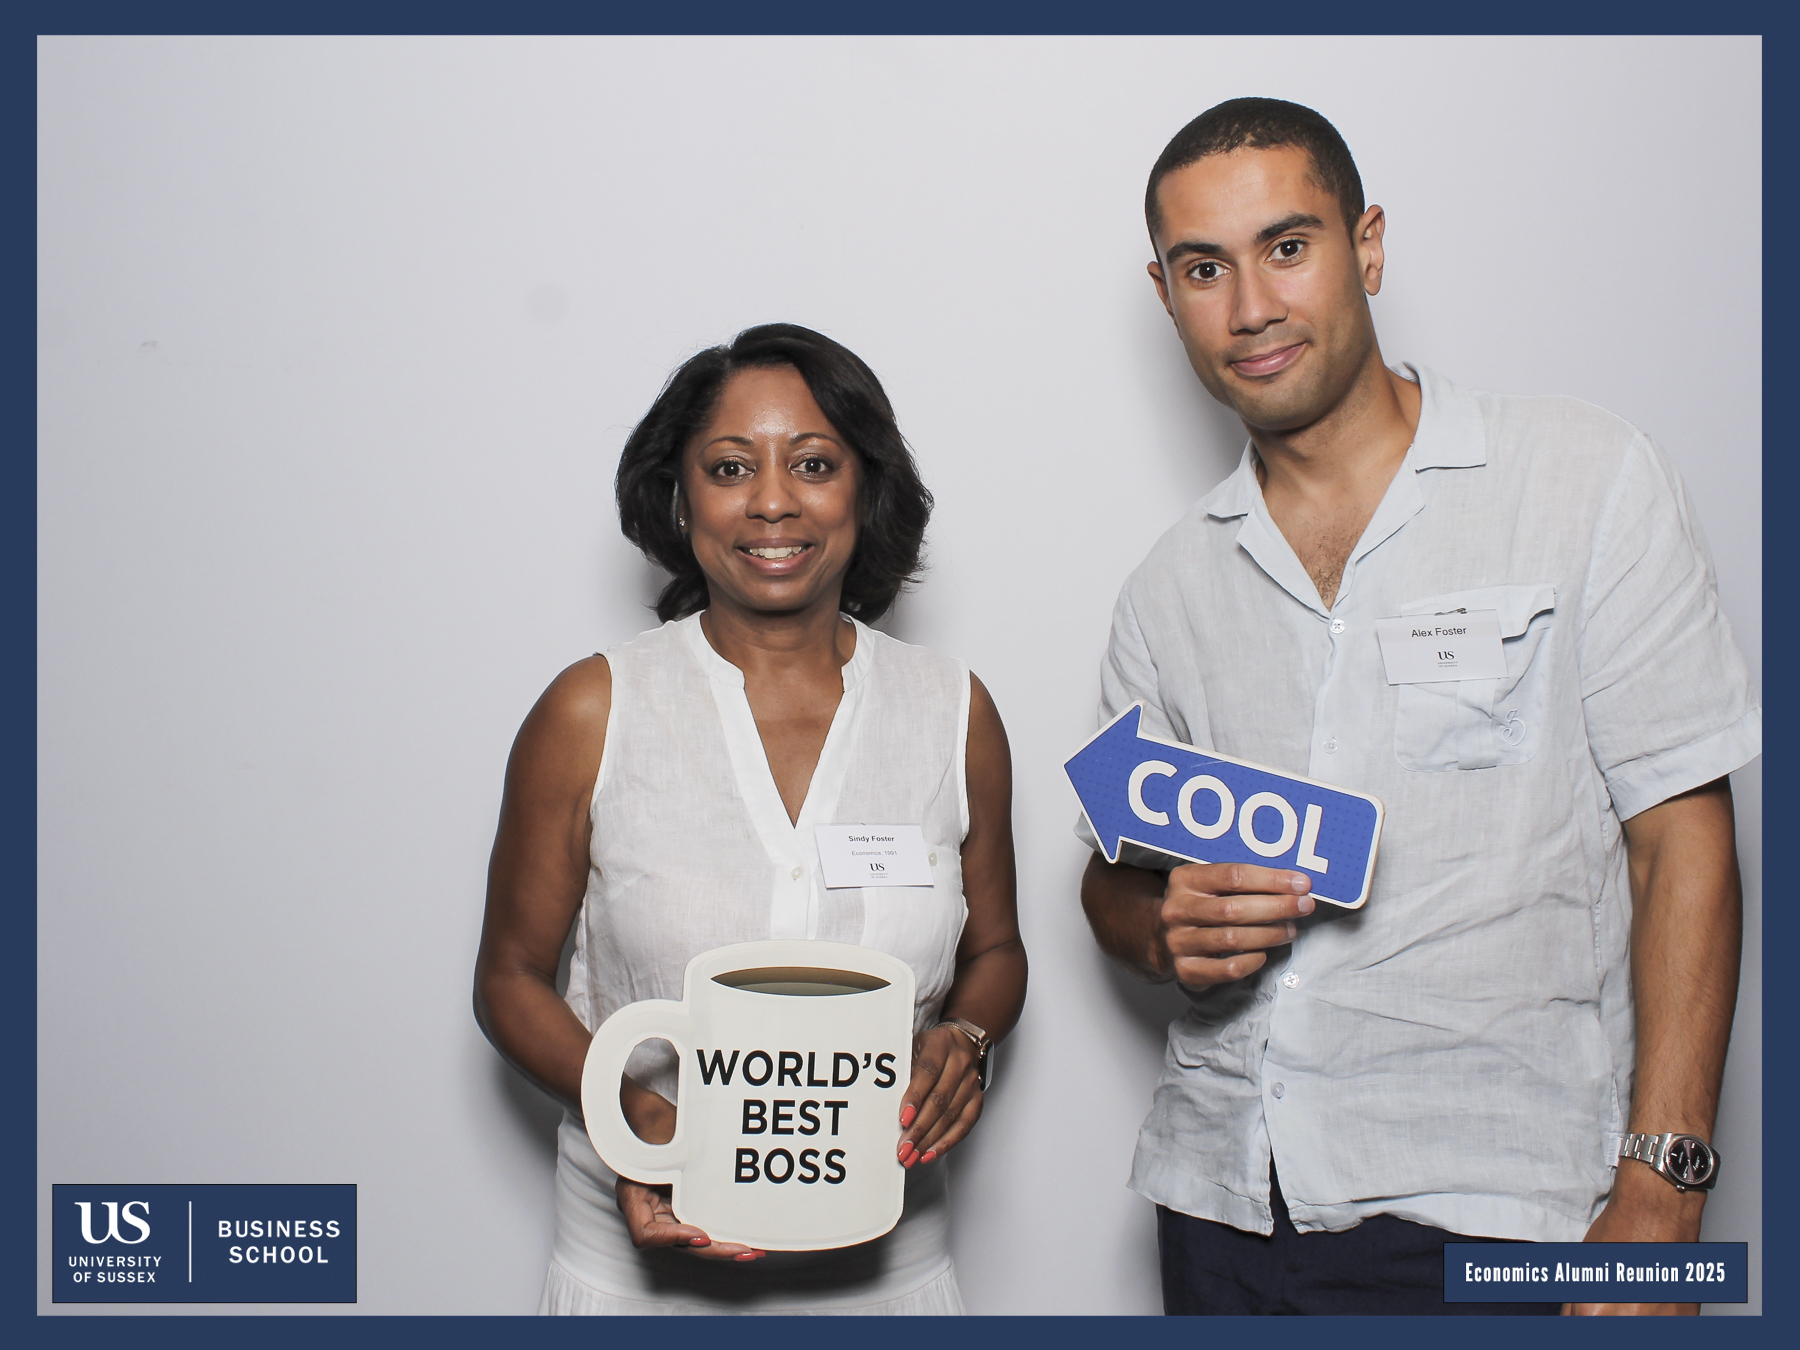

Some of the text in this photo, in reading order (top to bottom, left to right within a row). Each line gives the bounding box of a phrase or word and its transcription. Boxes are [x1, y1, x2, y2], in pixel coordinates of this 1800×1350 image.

[1411, 627, 1467, 638] Alex Foster
[1437, 650, 1455, 660] US
[1128, 760, 1329, 874] COOL
[848, 835, 869, 843] Sindy
[869, 862, 885, 872] US
[696, 1048, 897, 1089] WORLD'S
[742, 1098, 849, 1136] BEST
[734, 1147, 847, 1185] BOSS
